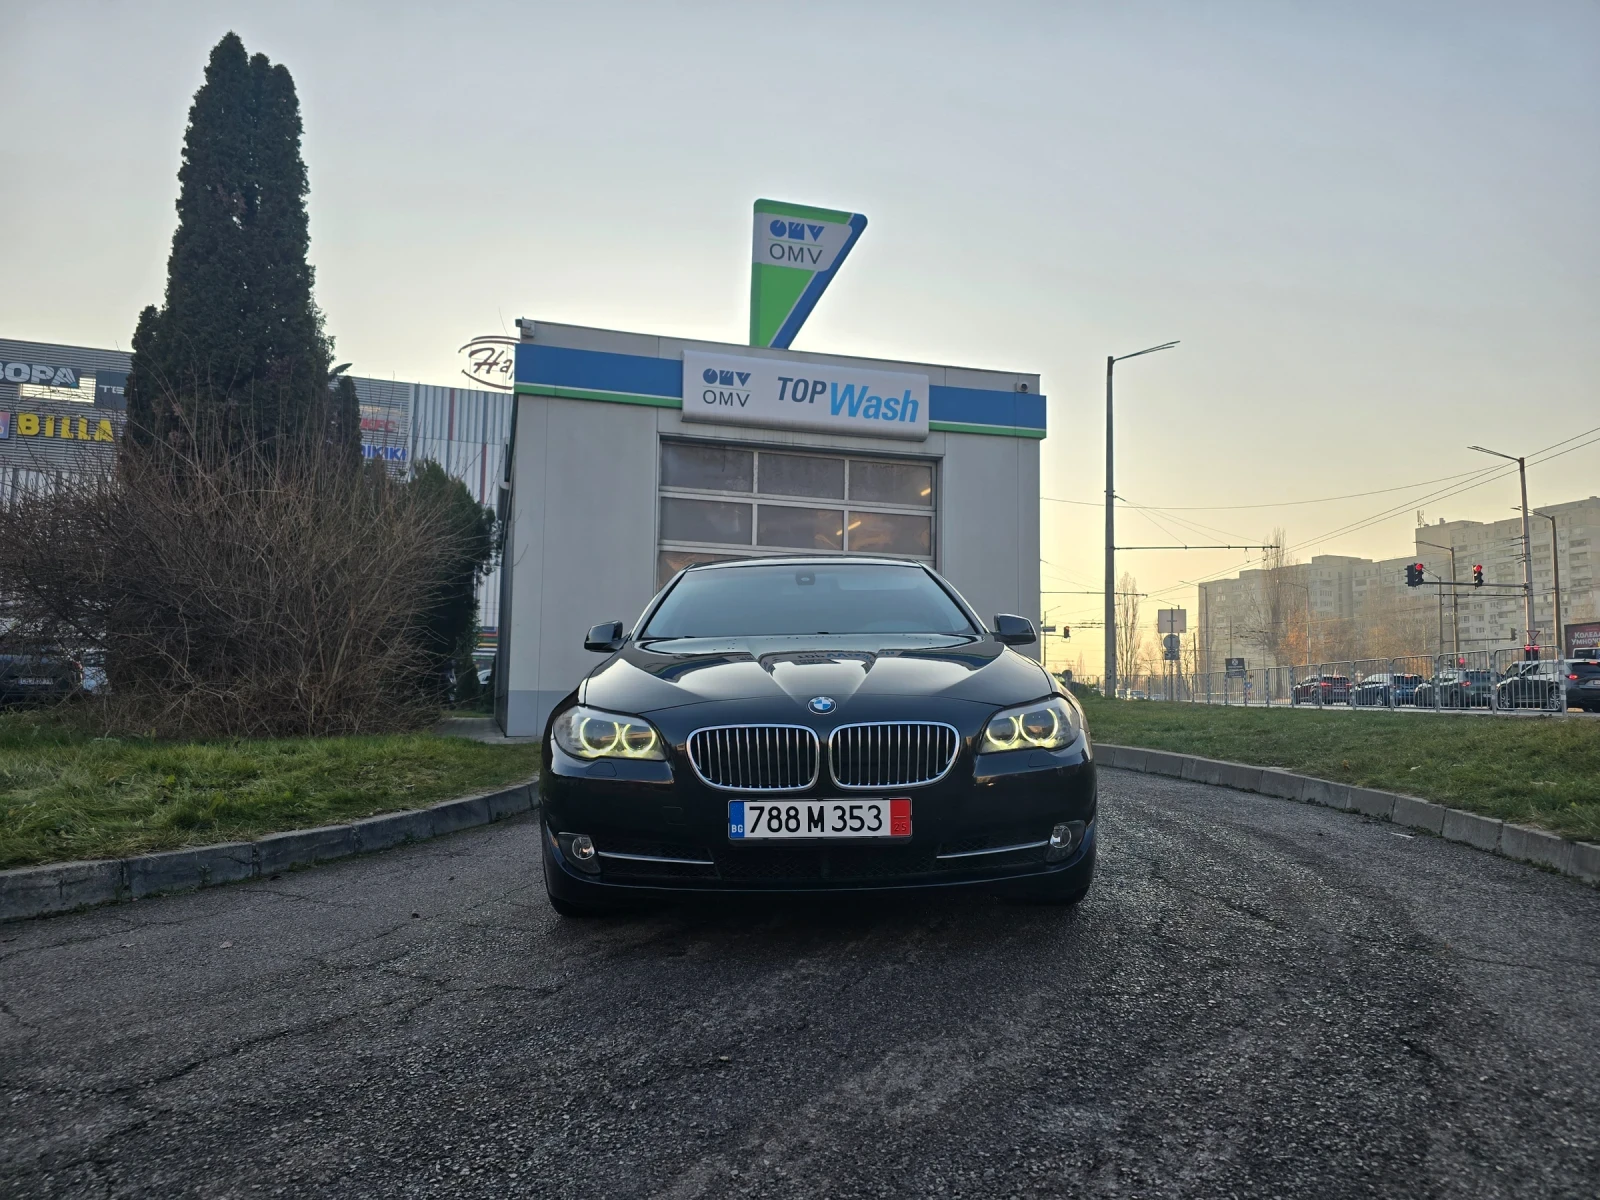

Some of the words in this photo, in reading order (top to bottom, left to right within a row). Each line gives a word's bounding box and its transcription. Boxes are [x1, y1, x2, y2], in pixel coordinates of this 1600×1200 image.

[769, 243, 823, 265] OMV
[703, 389, 750, 407] OMV
[777, 376, 827, 404] TOP
[830, 382, 919, 423] Wash
[17, 412, 115, 442] BILLA
[731, 824, 744, 833] BG
[749, 805, 801, 833] 788
[807, 805, 825, 833] M
[831, 804, 883, 832] 353
